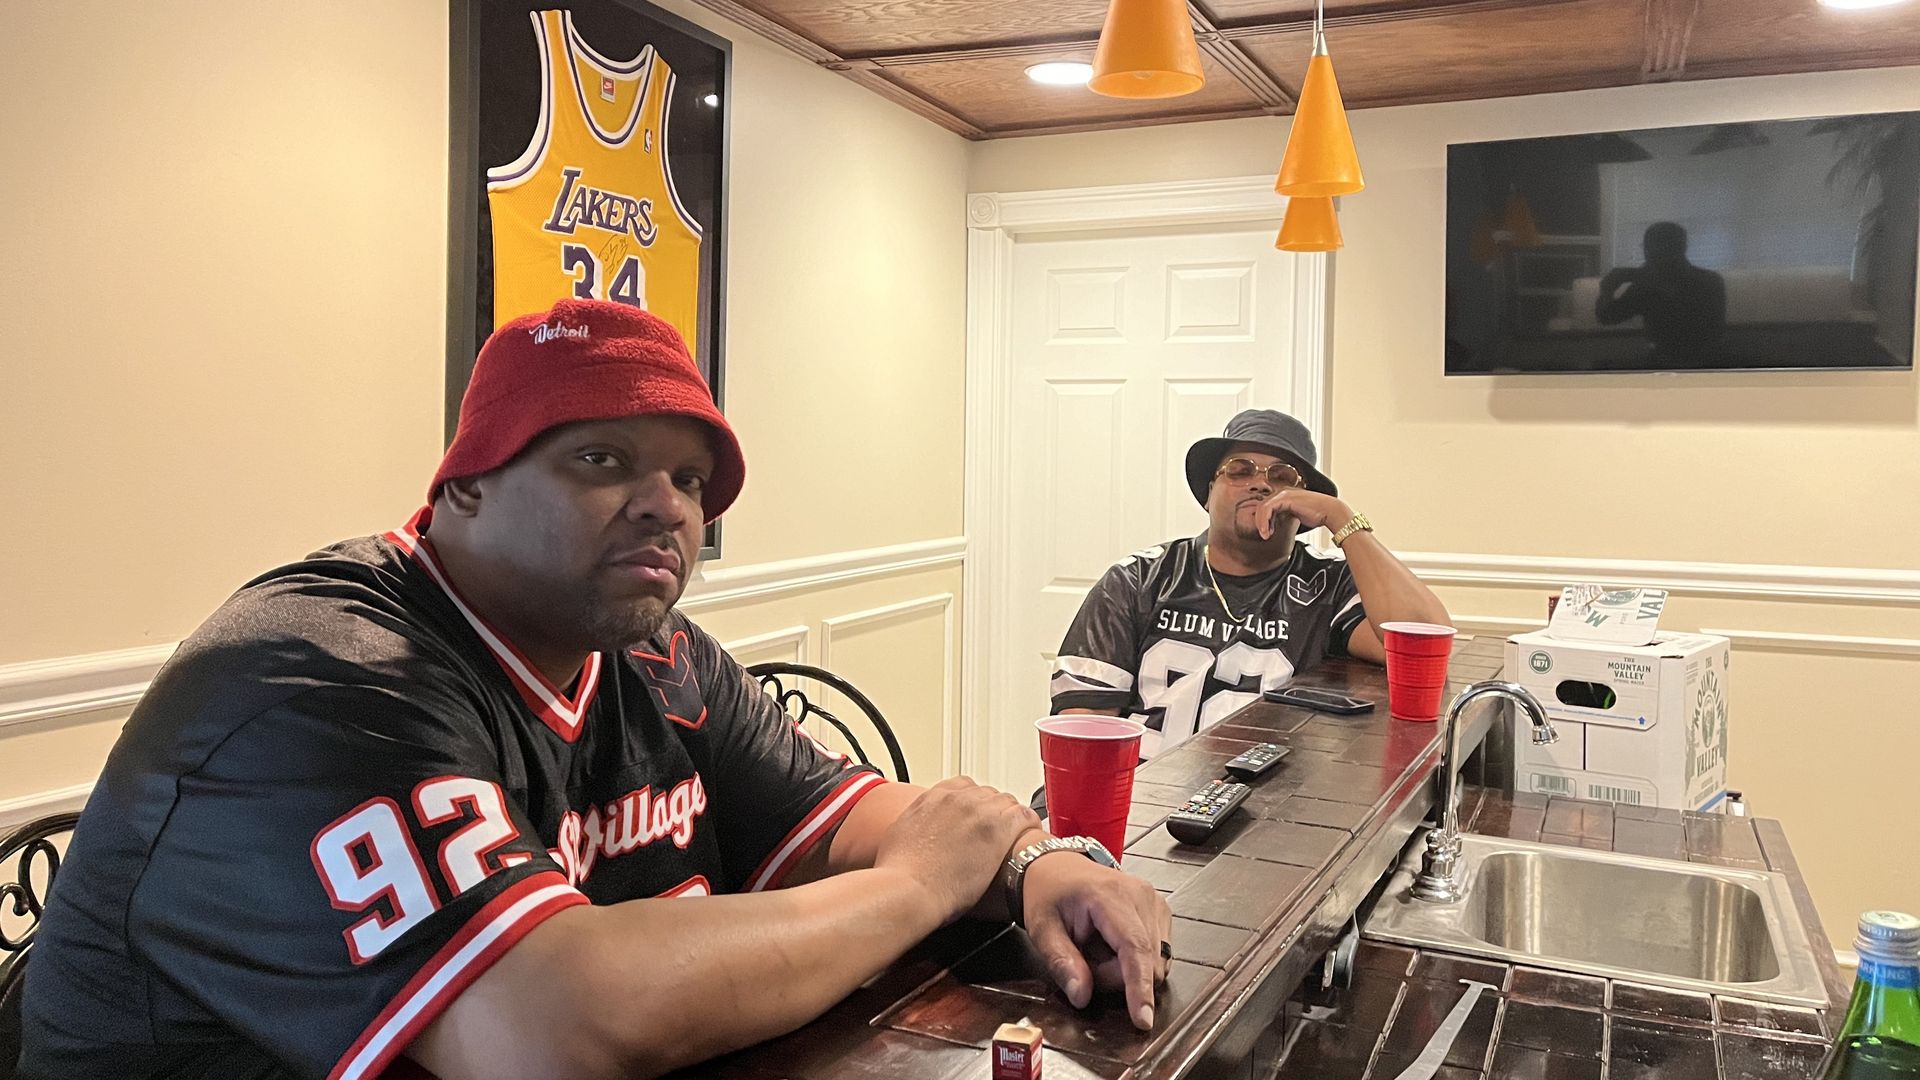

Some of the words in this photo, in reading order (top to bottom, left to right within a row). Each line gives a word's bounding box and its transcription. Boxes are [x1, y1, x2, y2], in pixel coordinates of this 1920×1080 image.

[541, 166, 658, 248] LAKERS
[561, 243, 648, 309] 34
[528, 321, 590, 345] Detroit
[1157, 609, 1216, 639] SLUM
[1222, 613, 1289, 642] VLAGE
[1607, 661, 1651, 673] MOUNTAIN
[1614, 670, 1645, 680] VALLEY
[1128, 637, 1295, 766] 92
[1696, 745, 1720, 778] VALLEY
[310, 774, 533, 967] 92
